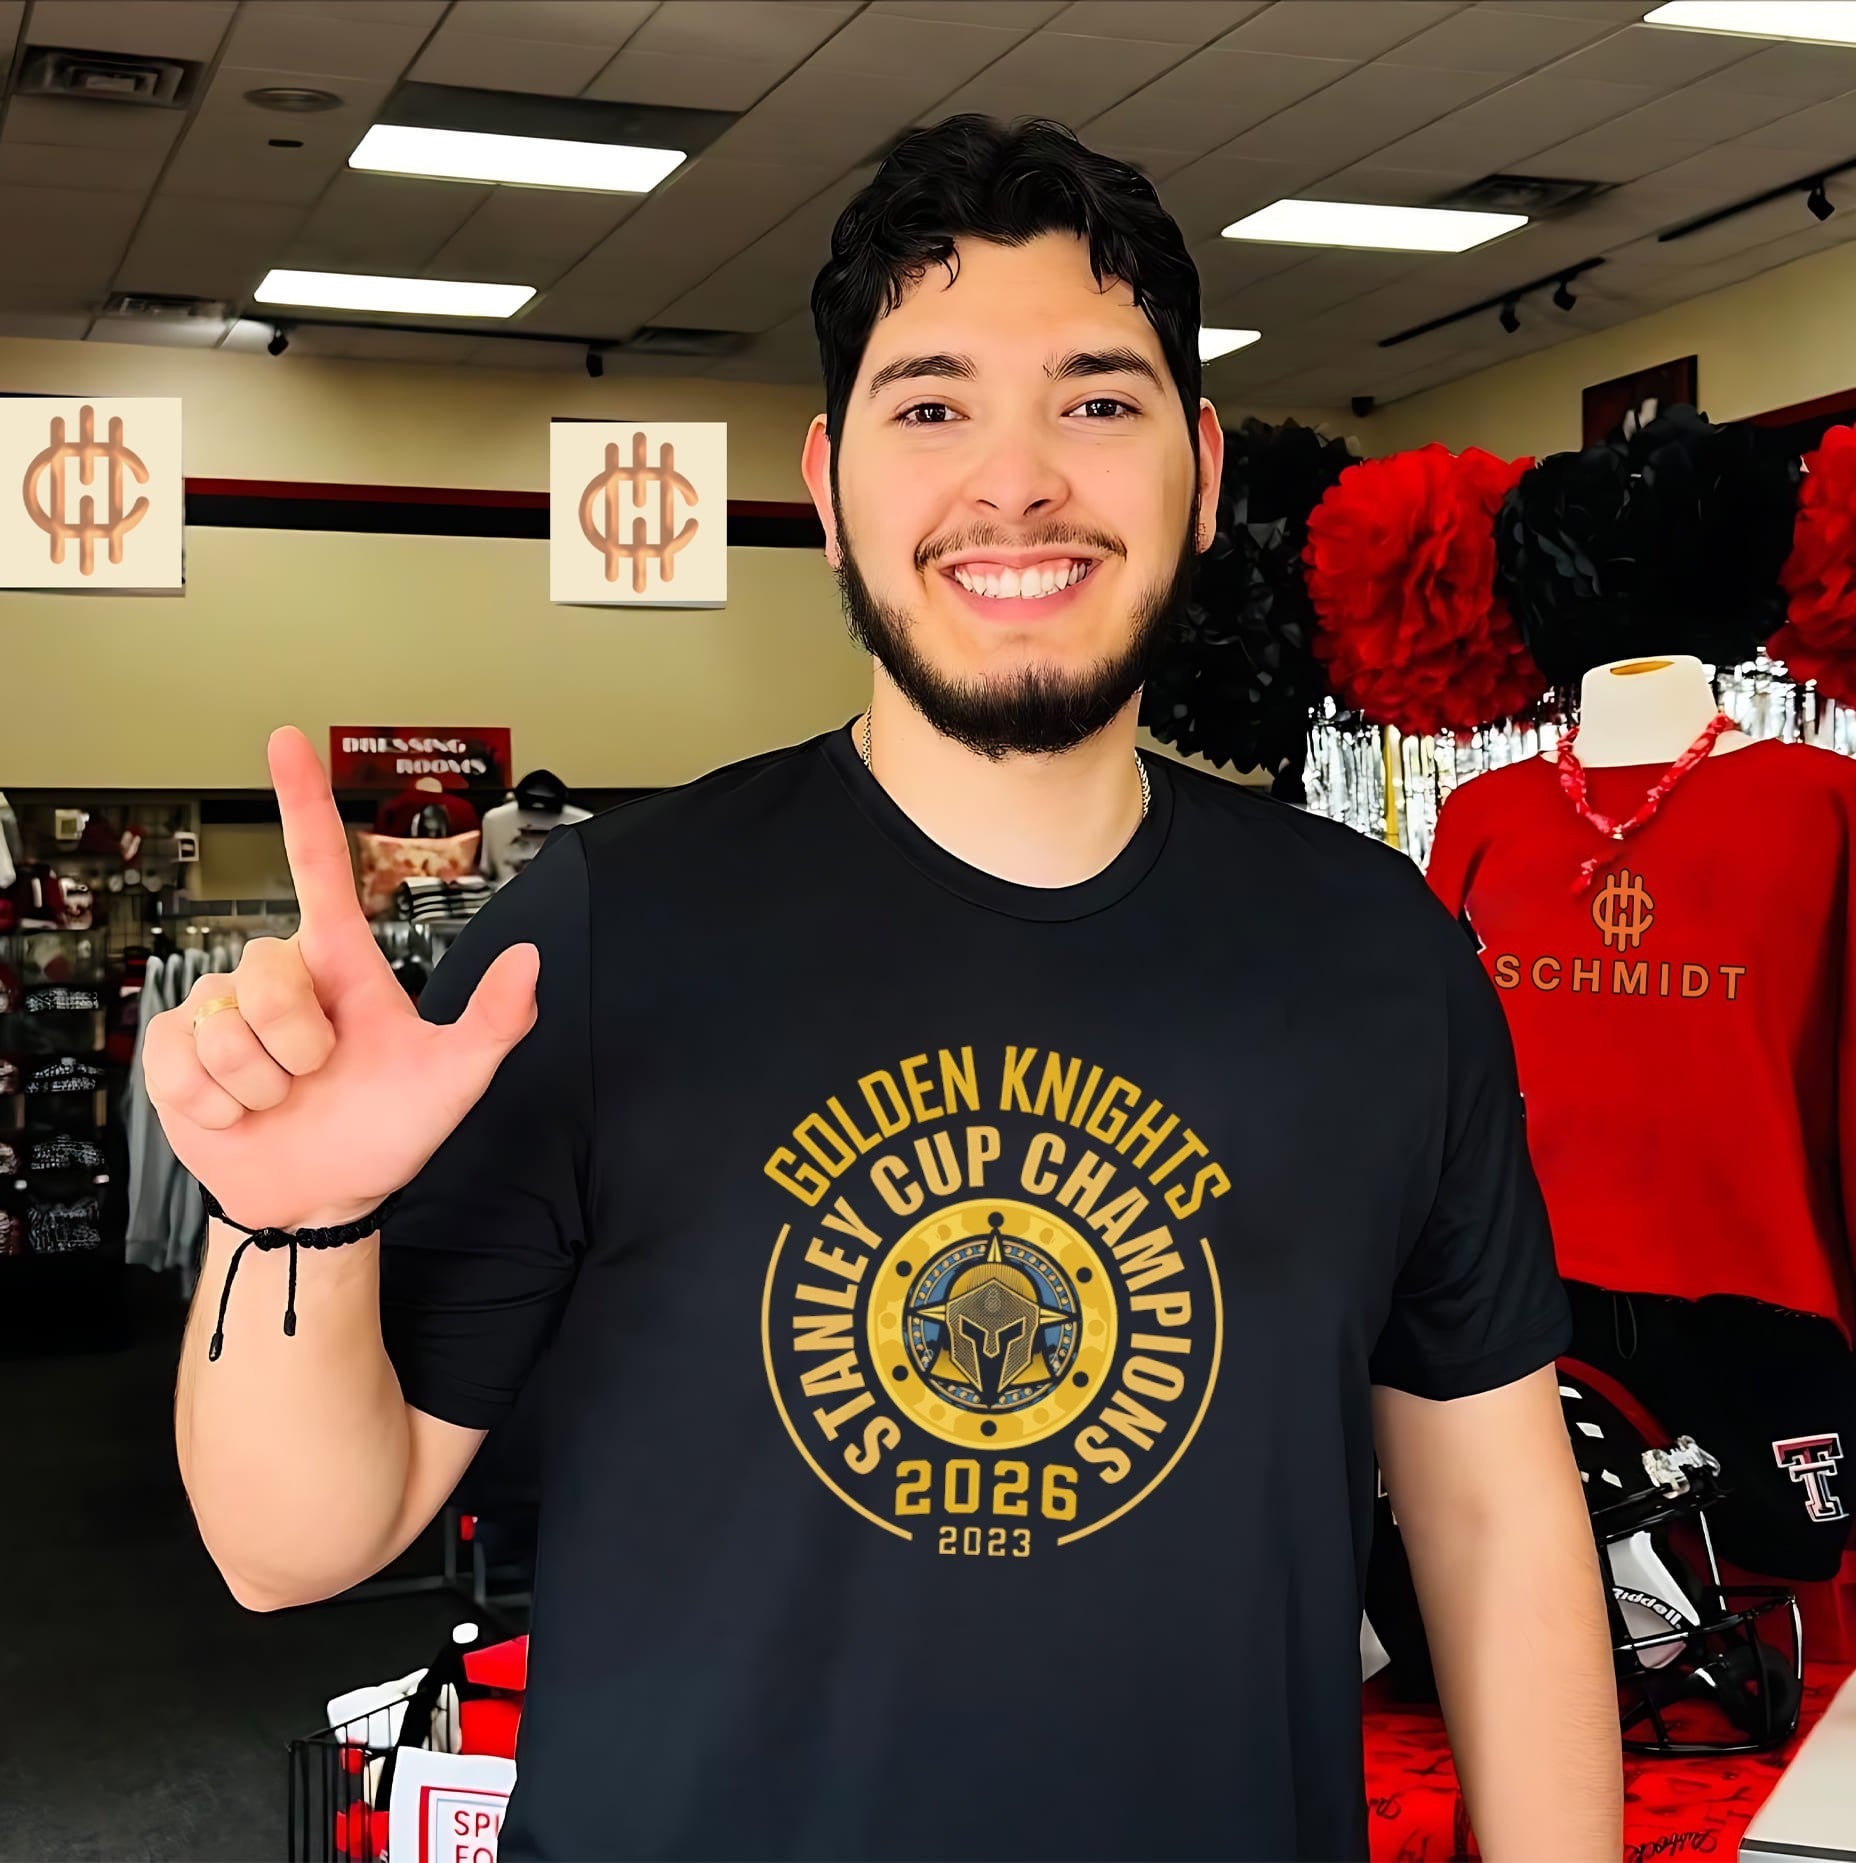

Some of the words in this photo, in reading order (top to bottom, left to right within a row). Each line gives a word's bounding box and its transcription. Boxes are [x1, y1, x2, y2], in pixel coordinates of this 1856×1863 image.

[342, 737, 466, 754] DRESSING
[396, 758, 487, 775] ROOMS
[1494, 953, 1747, 1000] SCHMIDT
[763, 1045, 981, 1207] GOLDEN
[999, 1045, 1232, 1220] KNIGHTS
[792, 1195, 902, 1475] STANLEY
[869, 1125, 1001, 1216] CUP
[1019, 1132, 1193, 1484] CHAMPIONS
[894, 1458, 1079, 1521] 2026
[938, 1526, 1032, 1558] 2023
